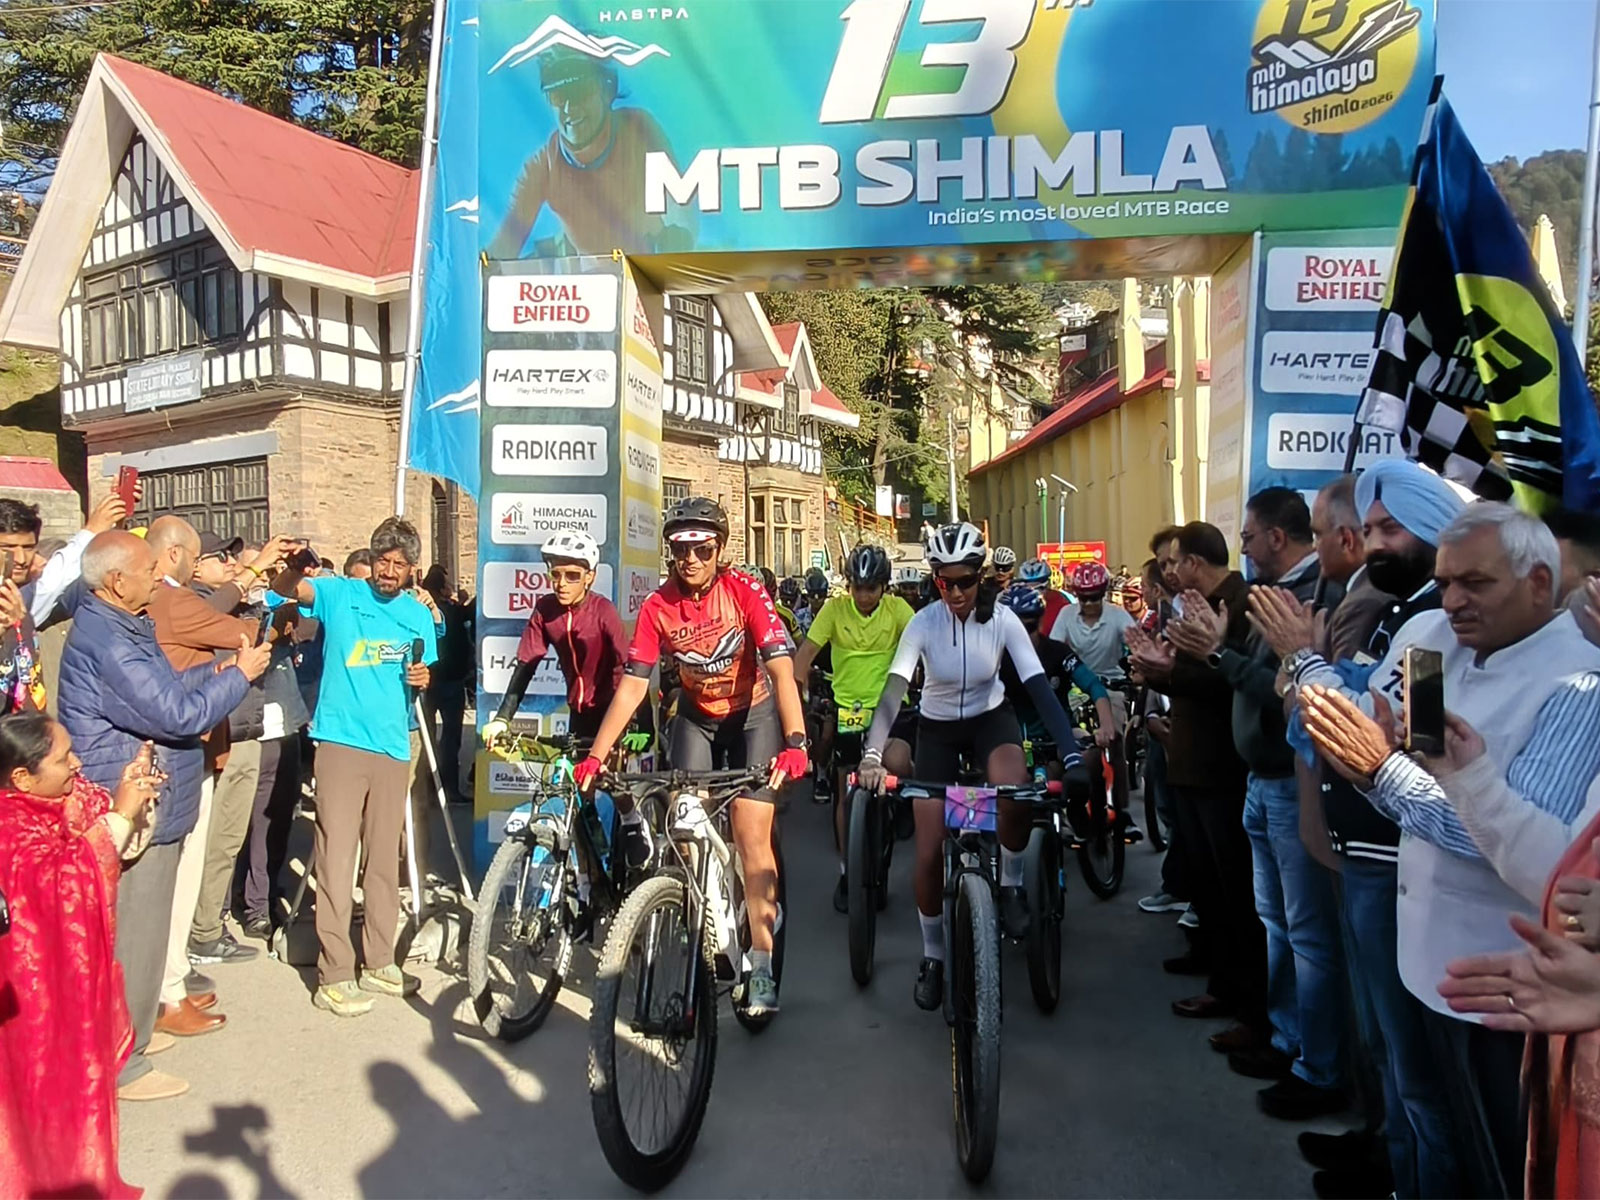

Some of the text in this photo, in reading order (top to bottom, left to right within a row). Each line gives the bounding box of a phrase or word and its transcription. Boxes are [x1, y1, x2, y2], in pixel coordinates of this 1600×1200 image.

[819, 0, 1037, 124] 13
[1252, 61, 1287, 85] mtb
[1251, 59, 1376, 112] himalaya
[1303, 91, 1393, 126] shimla 2026
[645, 125, 1227, 214] MTB SHIMLA
[1000, 205, 1056, 222] most
[1060, 201, 1120, 219] loved
[1124, 200, 1170, 217] MTB
[1175, 200, 1230, 215] Race
[1305, 255, 1382, 278] ROYAL
[519, 282, 582, 303] ROYAL
[513, 305, 590, 325] ENFIELD
[1270, 352, 1370, 369] HARTE
[493, 368, 592, 383] HARTEX
[502, 439, 597, 461] RADKAAT
[533, 507, 597, 519] HIMACHAL
[533, 520, 589, 531] TOURISM
[515, 568, 552, 590] ROY
